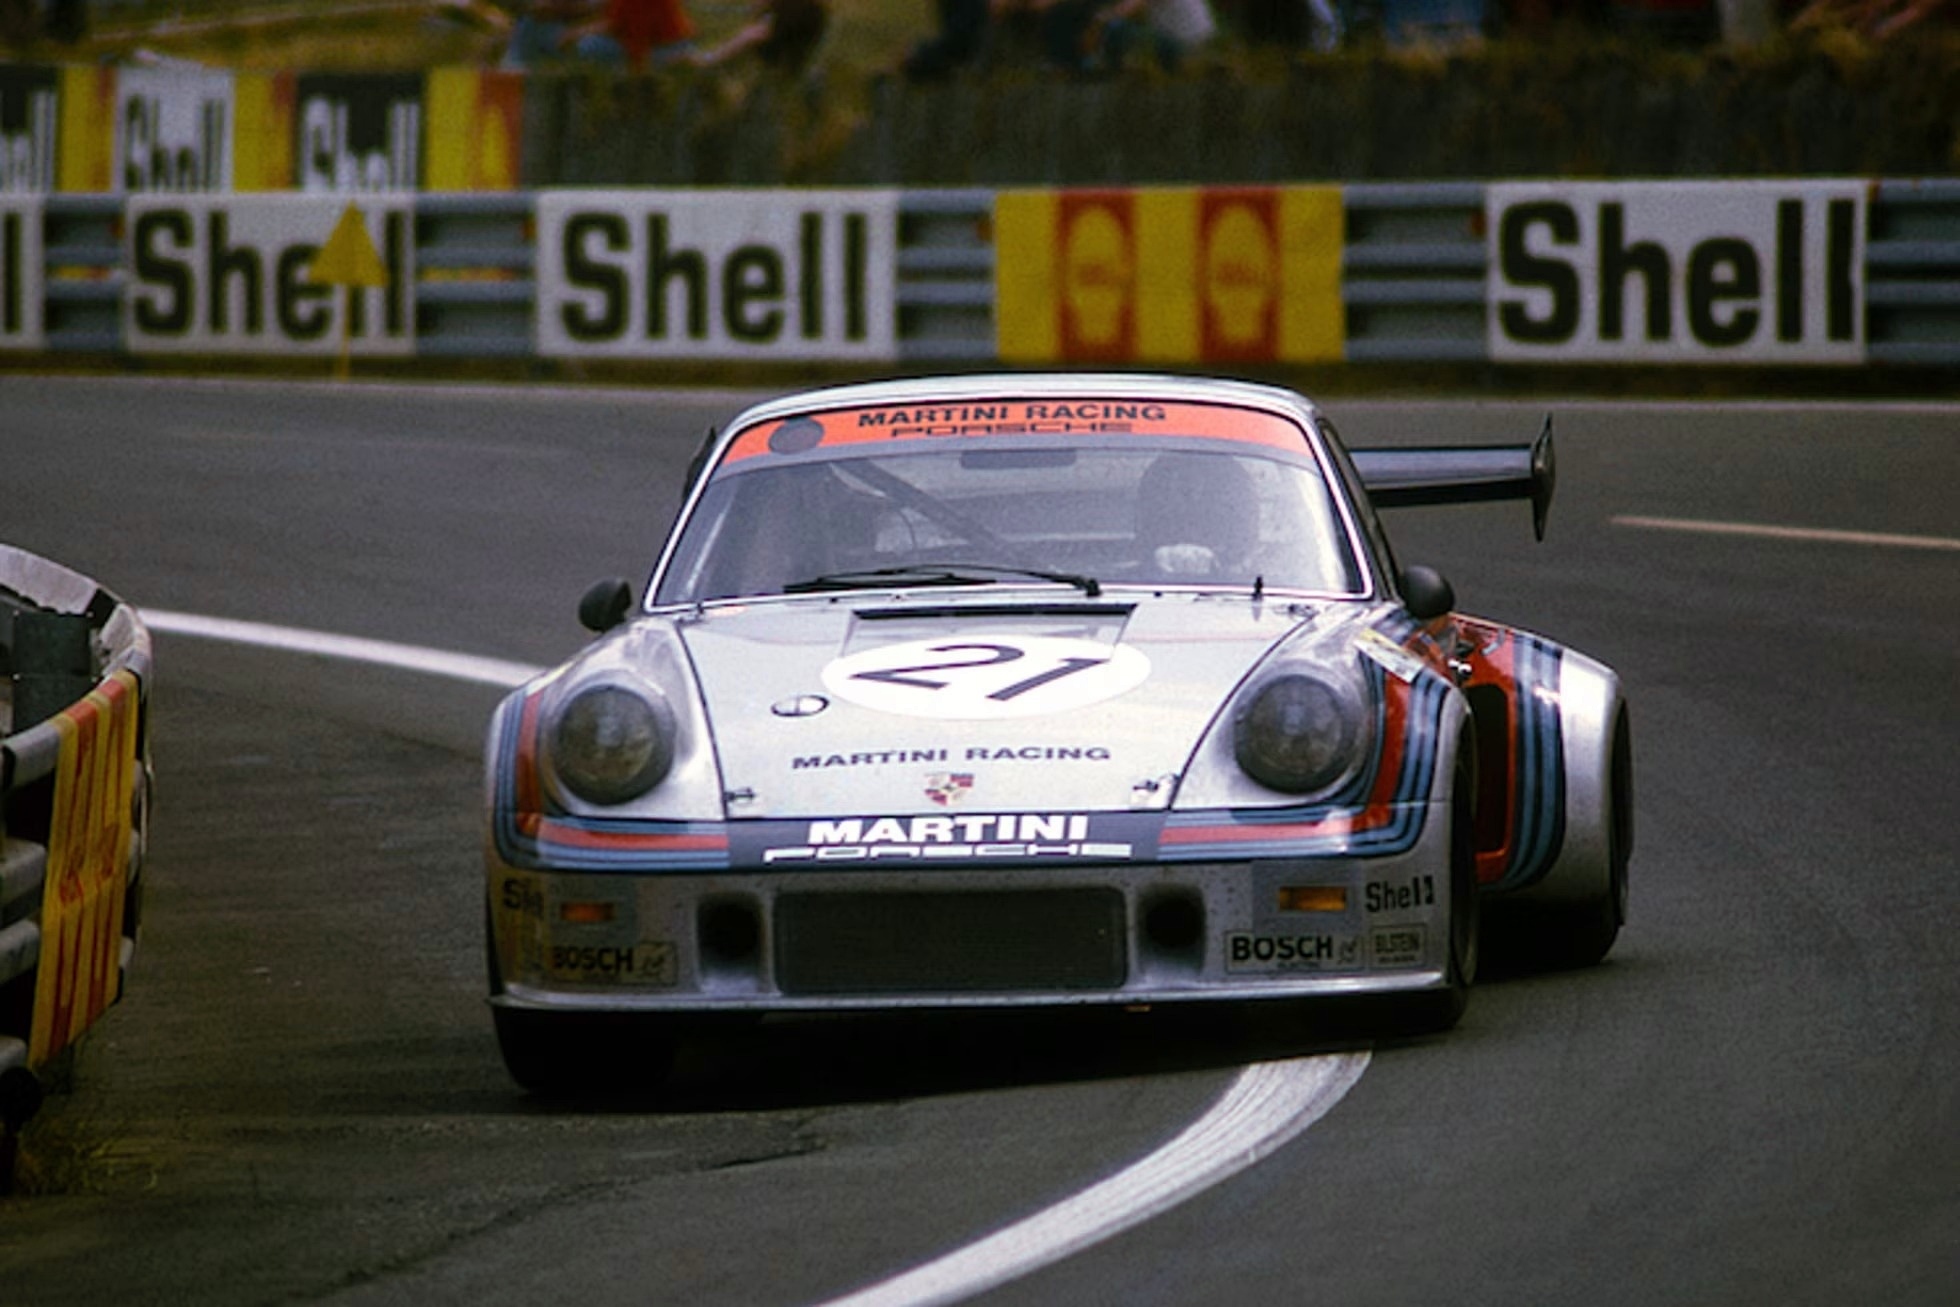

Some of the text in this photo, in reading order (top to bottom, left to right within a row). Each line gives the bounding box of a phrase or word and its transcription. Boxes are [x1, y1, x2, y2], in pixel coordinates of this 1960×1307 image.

[561, 211, 867, 344] Shell
[1502, 199, 1856, 348] Shell
[858, 403, 1166, 425] MARTINI RACING
[892, 423, 1132, 437] PORSCHE
[850, 644, 1112, 702] 21
[792, 745, 1111, 769] MARTINI RACING
[808, 815, 1088, 845] MARTINI
[763, 843, 1133, 864] PORSCHE
[1365, 875, 1434, 912] Shell
[553, 946, 634, 973] BOSCH
[1232, 936, 1333, 961] BOSCH
